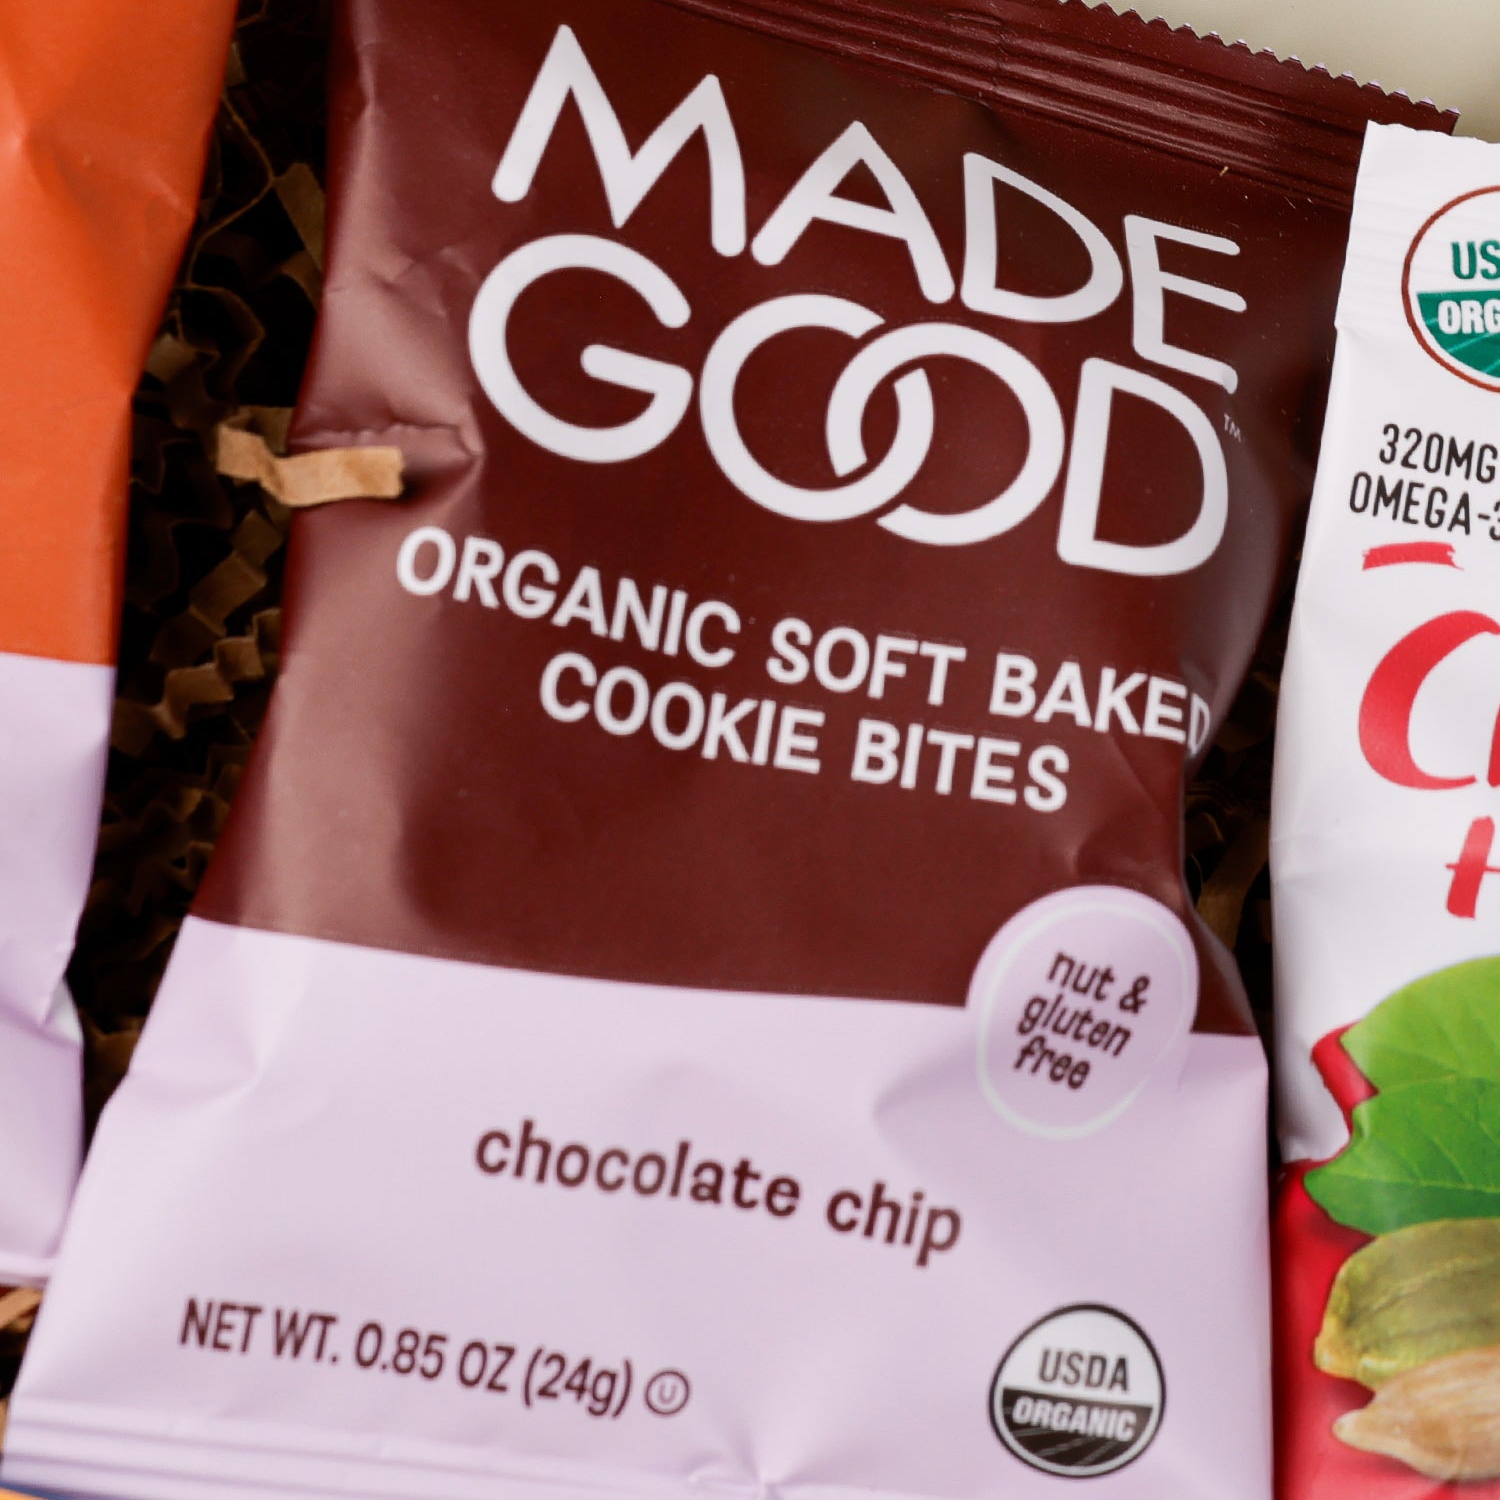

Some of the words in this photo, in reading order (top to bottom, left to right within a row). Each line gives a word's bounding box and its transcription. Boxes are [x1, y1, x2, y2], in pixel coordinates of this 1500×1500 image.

[490, 23, 1248, 394] MADE
[466, 233, 1230, 577] GOOD
[1379, 422, 1499, 484] 320MG
[395, 526, 741, 668] ORGANIC
[766, 617, 966, 707] SOFT
[989, 653, 1212, 757] BAKED
[538, 653, 825, 775] COOKIE
[851, 719, 1070, 813] BITES
[1017, 993, 1132, 1057] gluten
[1047, 952, 1115, 1002] nut
[1118, 975, 1151, 1014] &
[1014, 1035, 1091, 1090] free
[474, 1119, 802, 1218] chocolate
[825, 1180, 963, 1268] chip
[180, 1297, 263, 1354] NET
[274, 1307, 340, 1364] WT.
[354, 1321, 448, 1381] 0.85
[458, 1341, 516, 1393] OZ
[524, 1347, 633, 1420] (24g)
[1038, 1347, 1129, 1392] USDA
[1011, 1395, 1137, 1443] ORGANIC
